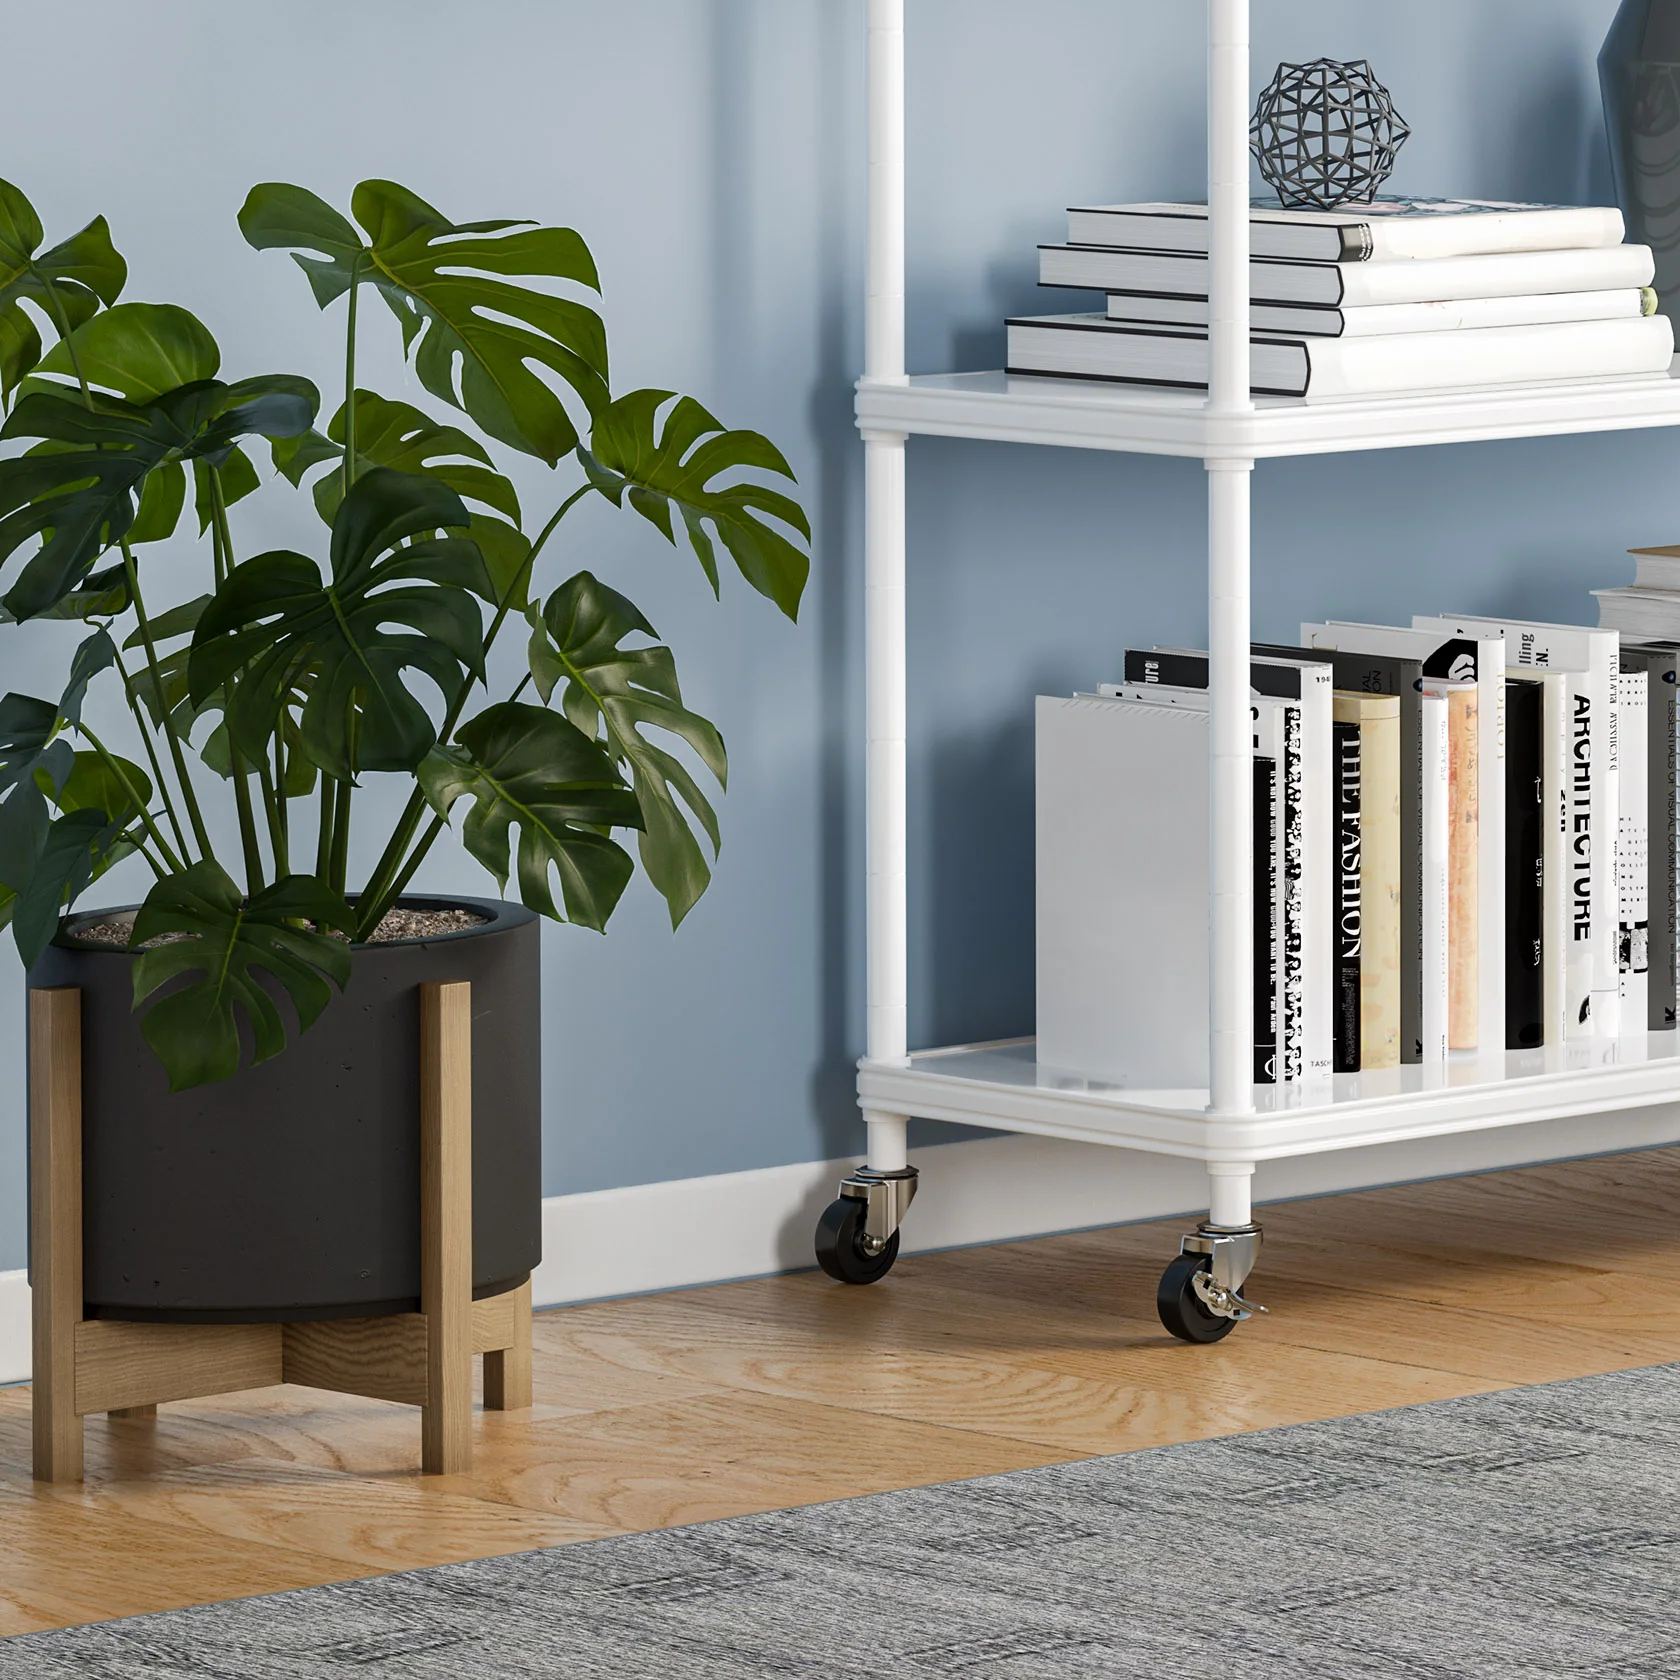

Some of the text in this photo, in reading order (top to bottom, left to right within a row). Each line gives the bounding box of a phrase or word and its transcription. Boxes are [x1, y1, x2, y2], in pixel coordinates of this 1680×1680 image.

[1341, 730, 1360, 803] THE
[1573, 694, 1591, 941] ARCHITECTURE
[1668, 700, 1676, 934] ESSENTIALS OF VISUAL COMMUNICATION
[1341, 810, 1361, 959] FASHION
